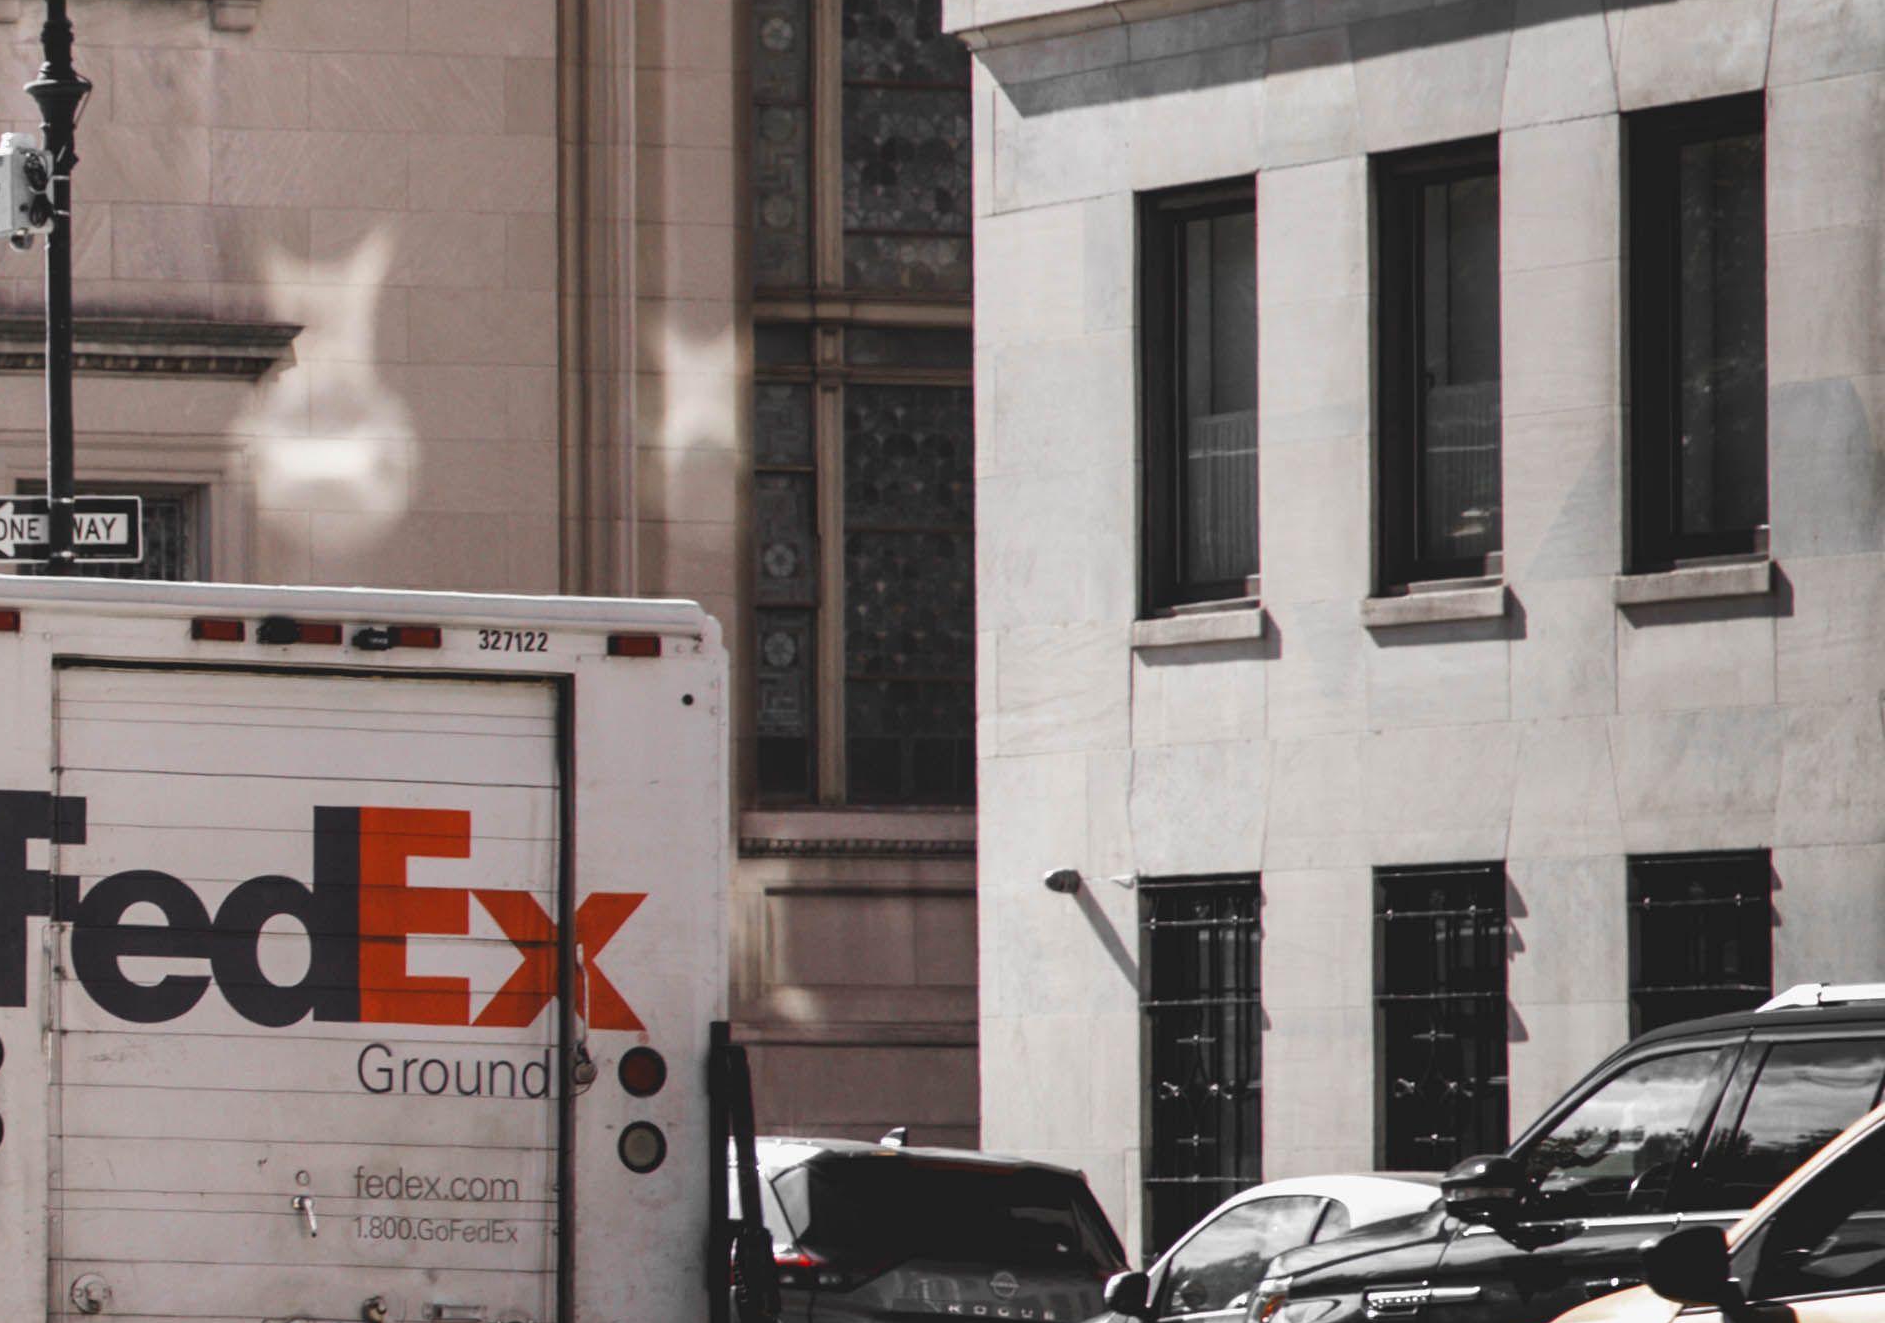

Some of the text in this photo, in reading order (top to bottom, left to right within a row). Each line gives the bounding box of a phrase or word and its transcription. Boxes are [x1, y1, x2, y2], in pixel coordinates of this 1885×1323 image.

[477, 629, 549, 653] 327122
[356, 1044, 550, 1100] Ground
[353, 1165, 520, 1201] fedex.com
[353, 1216, 519, 1243] 1.800.GoFedEx
